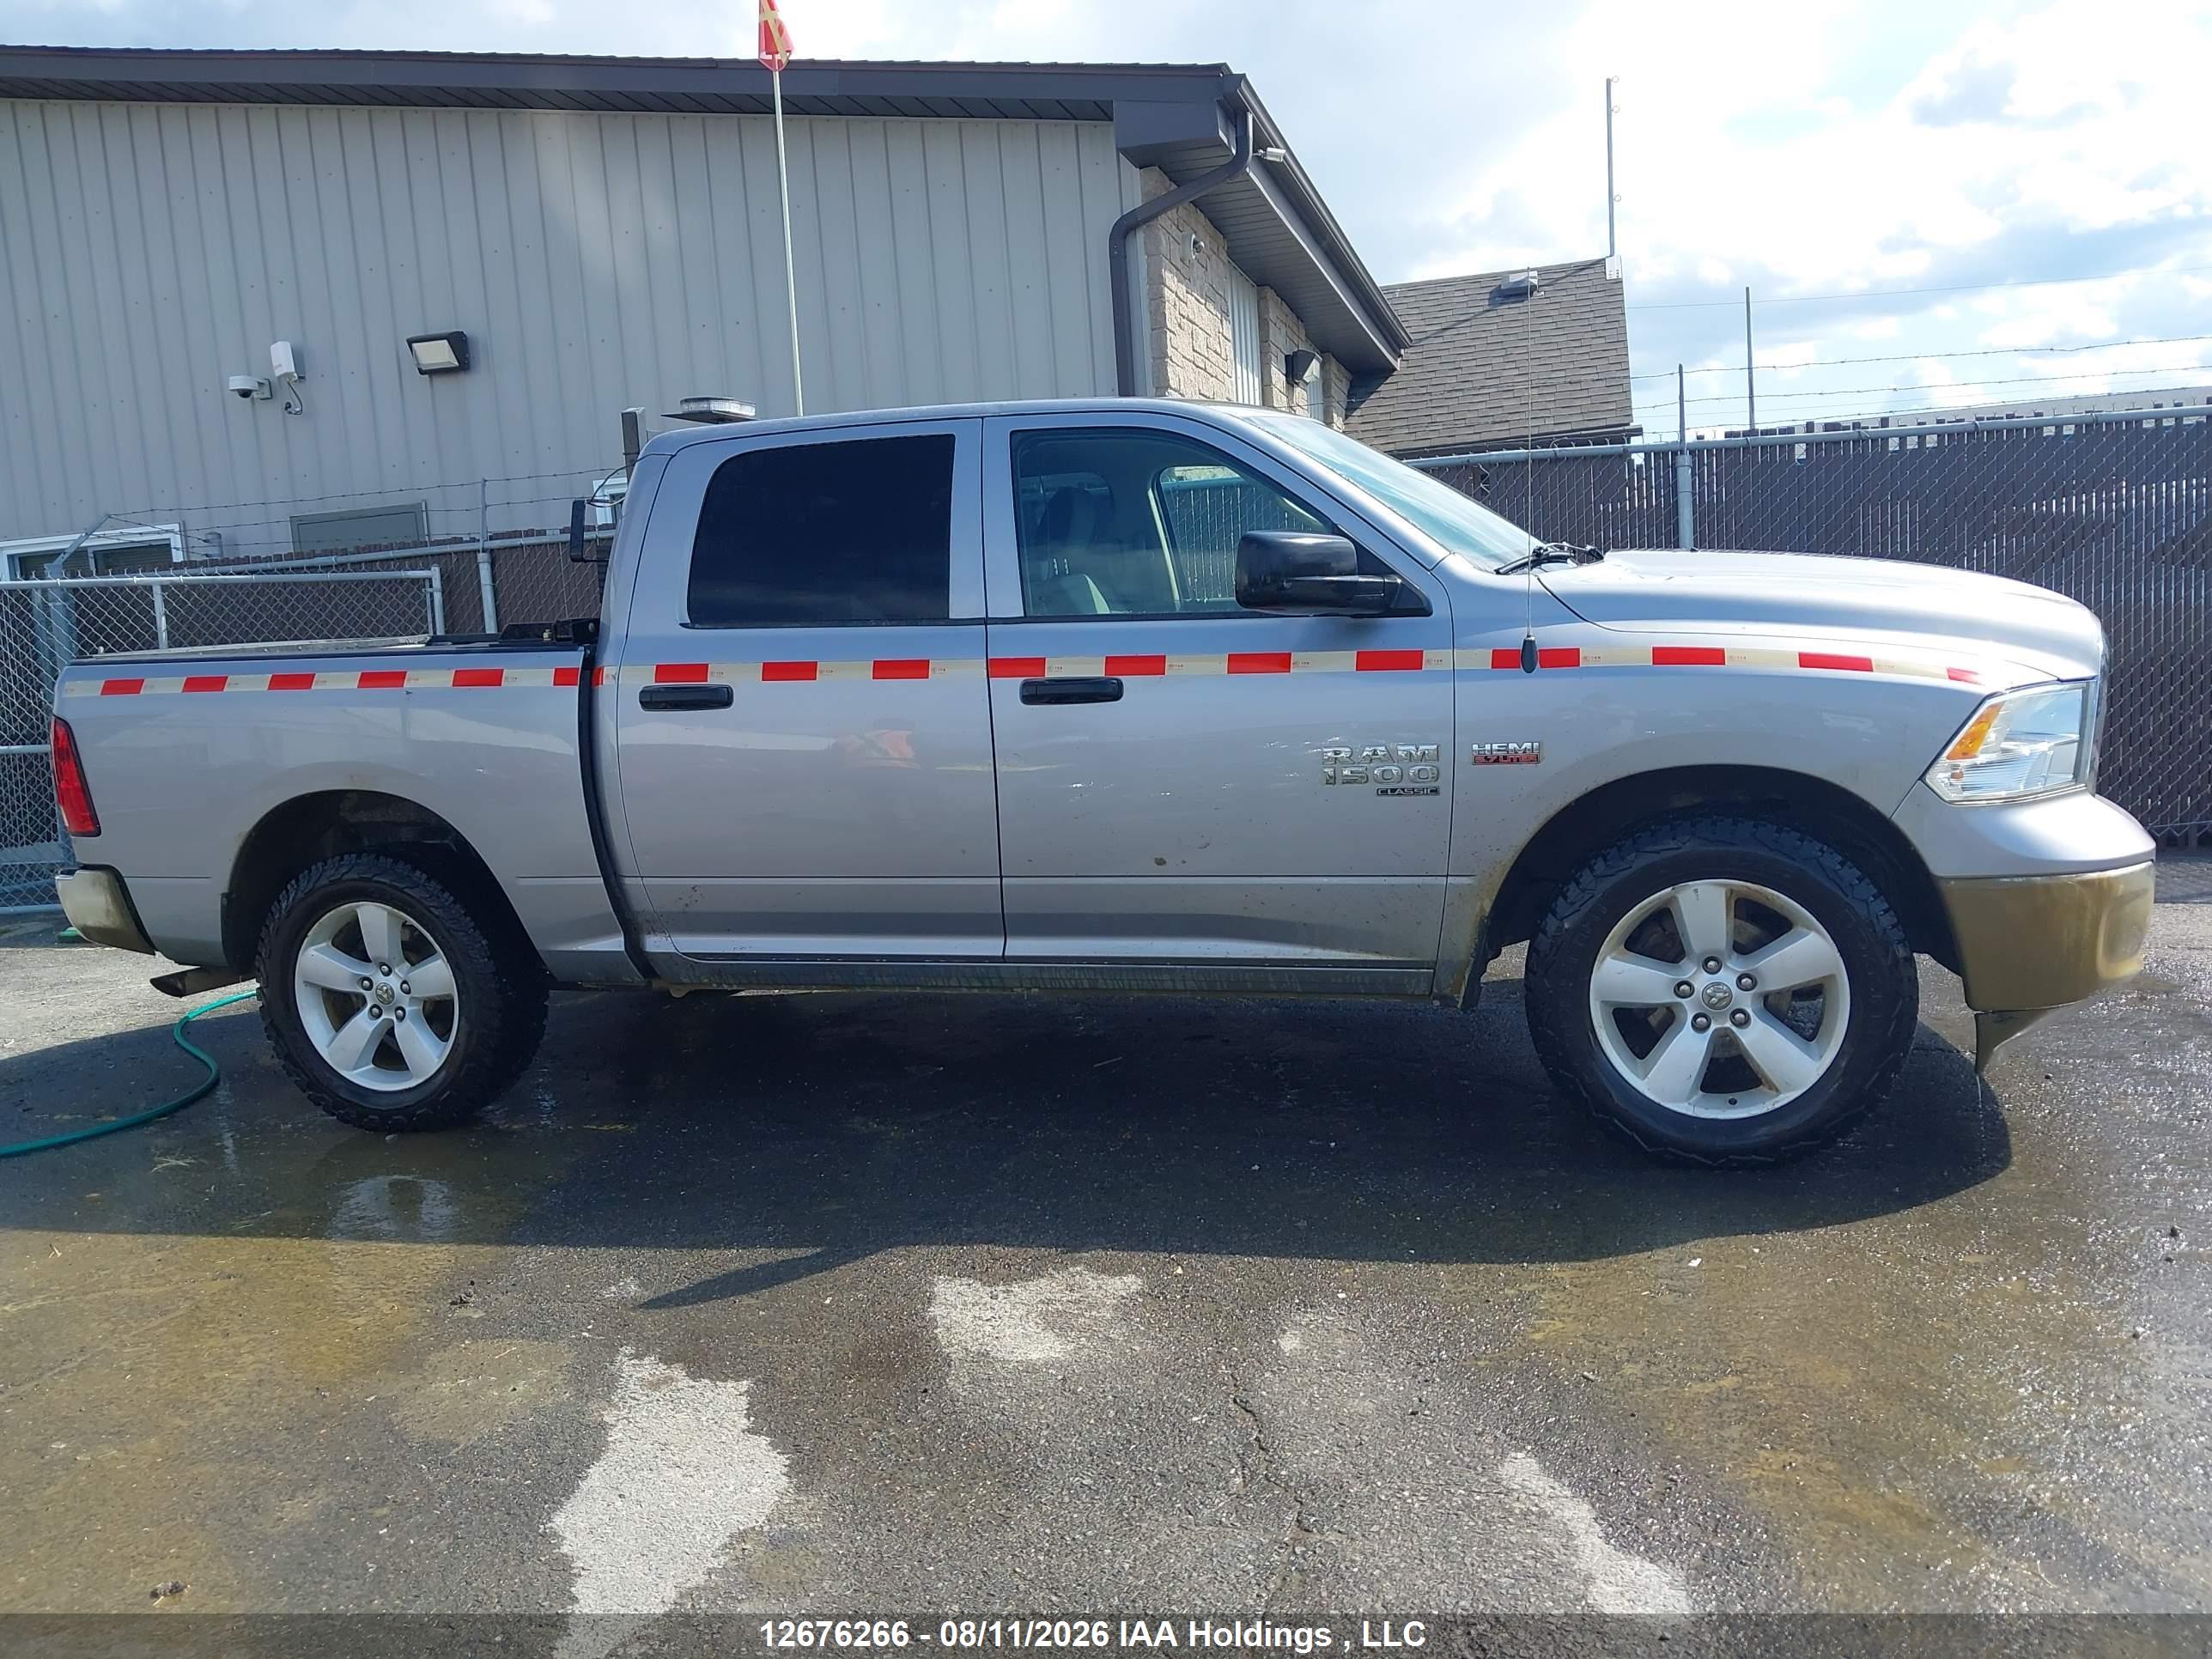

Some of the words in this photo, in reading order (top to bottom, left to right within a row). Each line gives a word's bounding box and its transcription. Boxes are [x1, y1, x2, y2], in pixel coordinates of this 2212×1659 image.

[1322, 744, 1439, 764] RAM
[1472, 742, 1540, 755] HEMI
[1323, 765, 1439, 785] 1500
